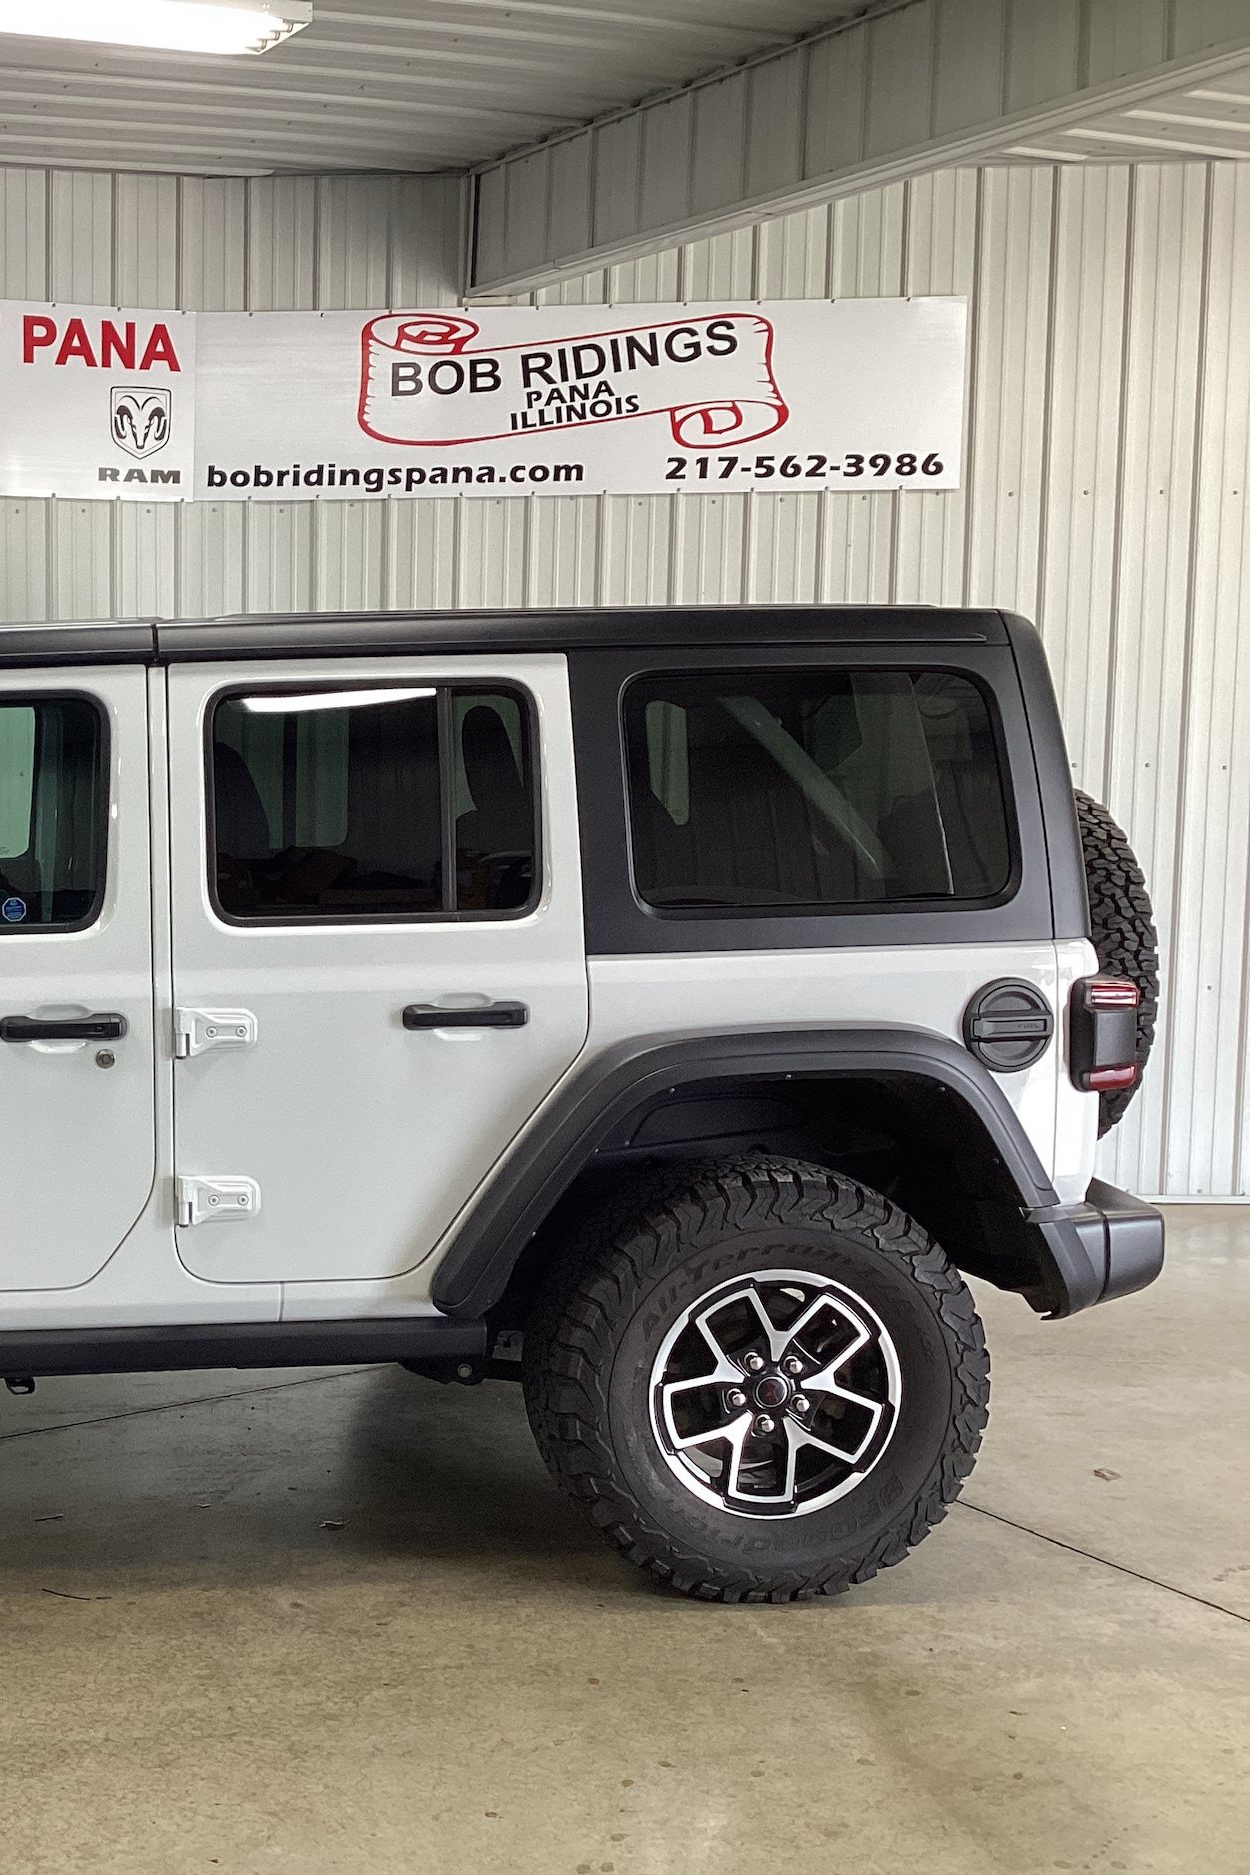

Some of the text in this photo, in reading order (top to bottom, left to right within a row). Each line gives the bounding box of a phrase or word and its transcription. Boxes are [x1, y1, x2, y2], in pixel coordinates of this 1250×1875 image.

[23, 315, 181, 372] PANA
[391, 320, 738, 397] BOB RIDINGS
[526, 380, 615, 410] PANA
[510, 394, 640, 431] ILLINOIS
[98, 467, 181, 484] RAM
[207, 460, 585, 493] bobridingspana.com
[665, 453, 944, 480] 217-562-3986
